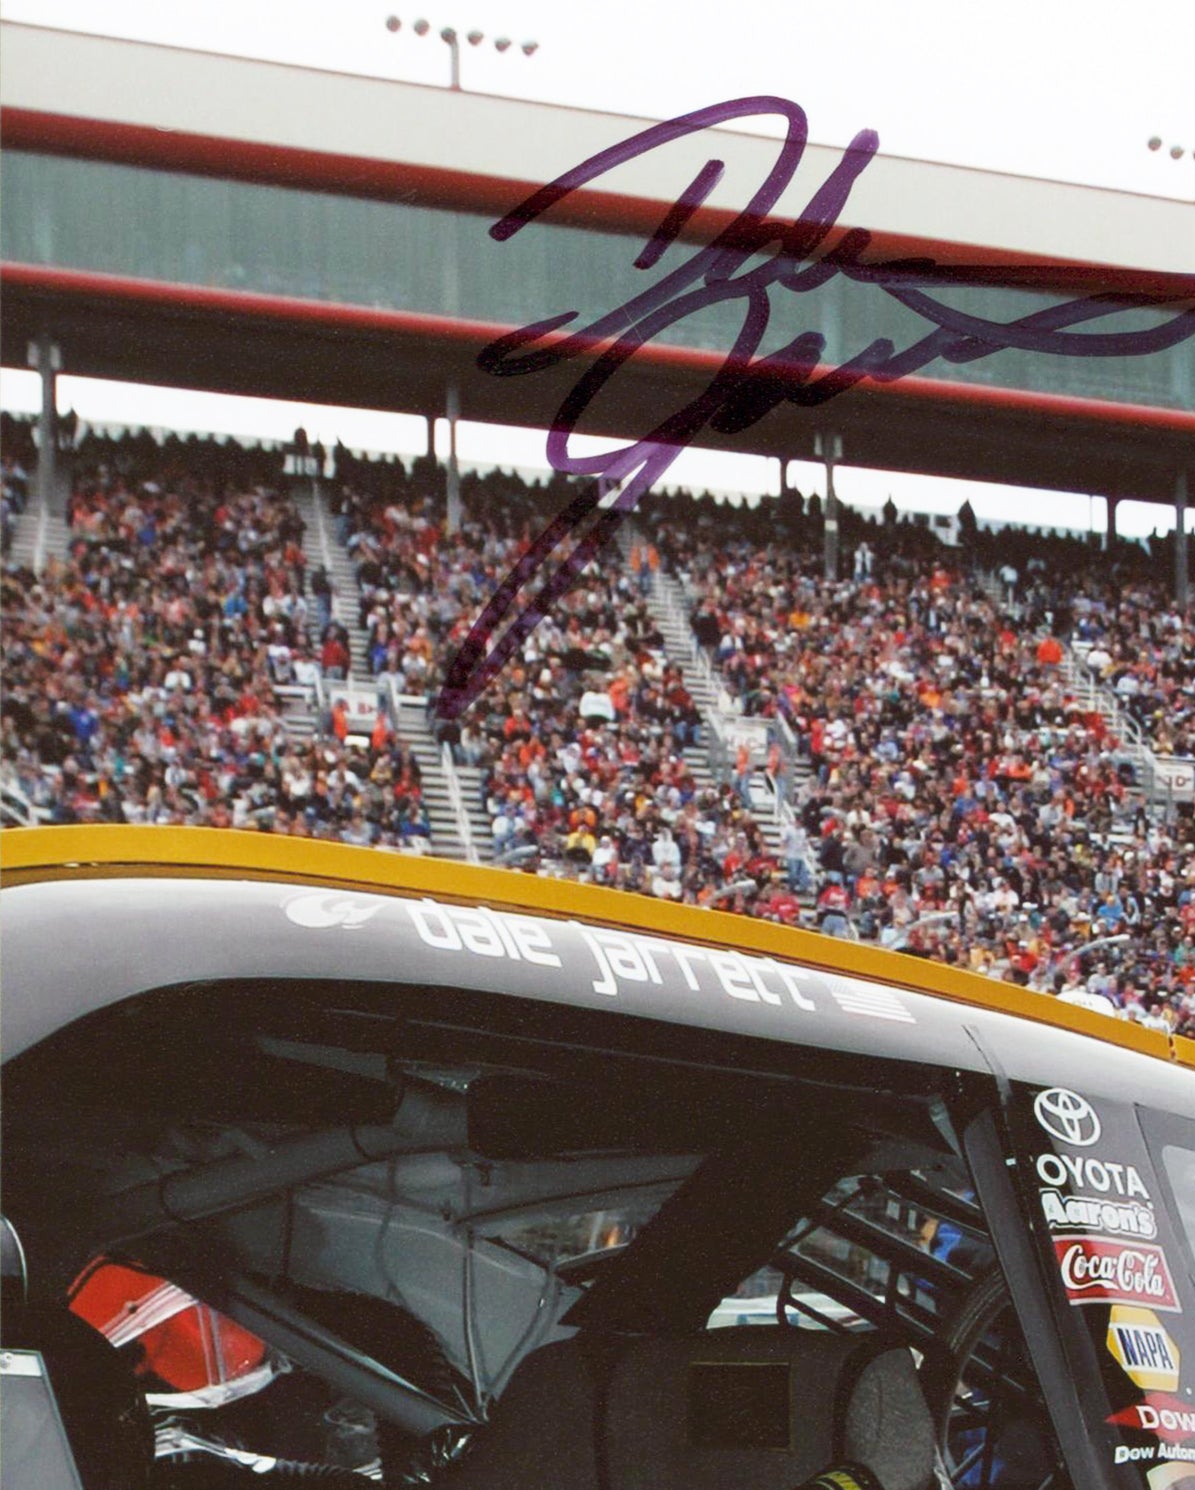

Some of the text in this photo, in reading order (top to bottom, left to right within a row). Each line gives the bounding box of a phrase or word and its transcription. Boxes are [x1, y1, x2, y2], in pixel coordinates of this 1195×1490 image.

[405, 897, 817, 1011] dale jarrett
[1036, 1153, 1150, 1199] OYOTA
[1039, 1188, 1157, 1239] Aaron's
[1061, 1244, 1165, 1297] Coca-Cola
[1116, 1327, 1174, 1370] NAPA
[1114, 1445, 1155, 1464] Dow
